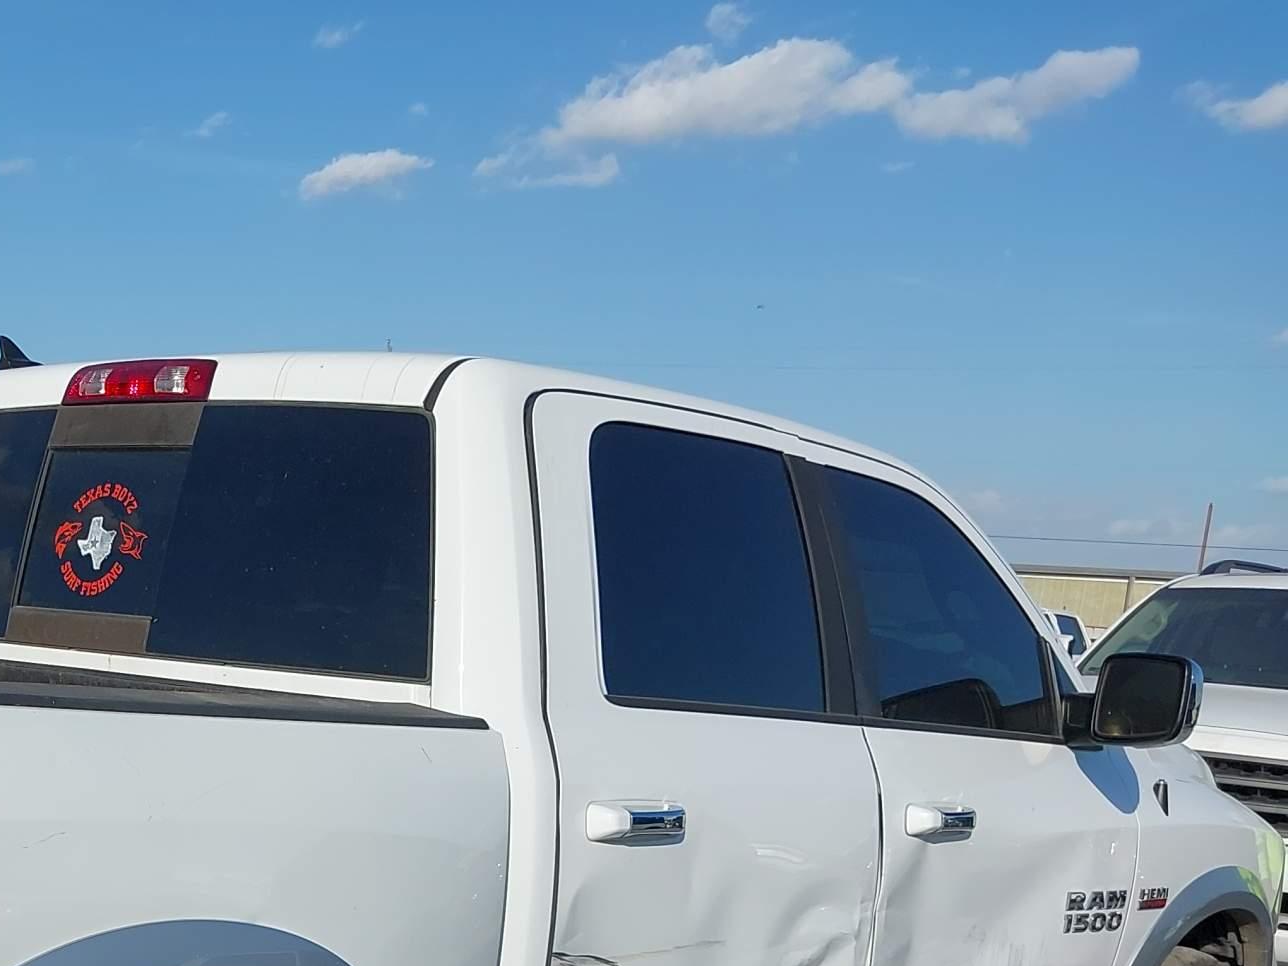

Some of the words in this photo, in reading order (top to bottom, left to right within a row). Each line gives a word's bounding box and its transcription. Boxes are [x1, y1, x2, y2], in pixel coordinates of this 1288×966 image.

[73, 483, 111, 513] TEXAS
[60, 561, 82, 592] SURF
[80, 561, 124, 596] FISHING
[1065, 889, 1128, 911] RAM
[1139, 887, 1169, 900] HEMI
[1063, 911, 1123, 934] 1500
